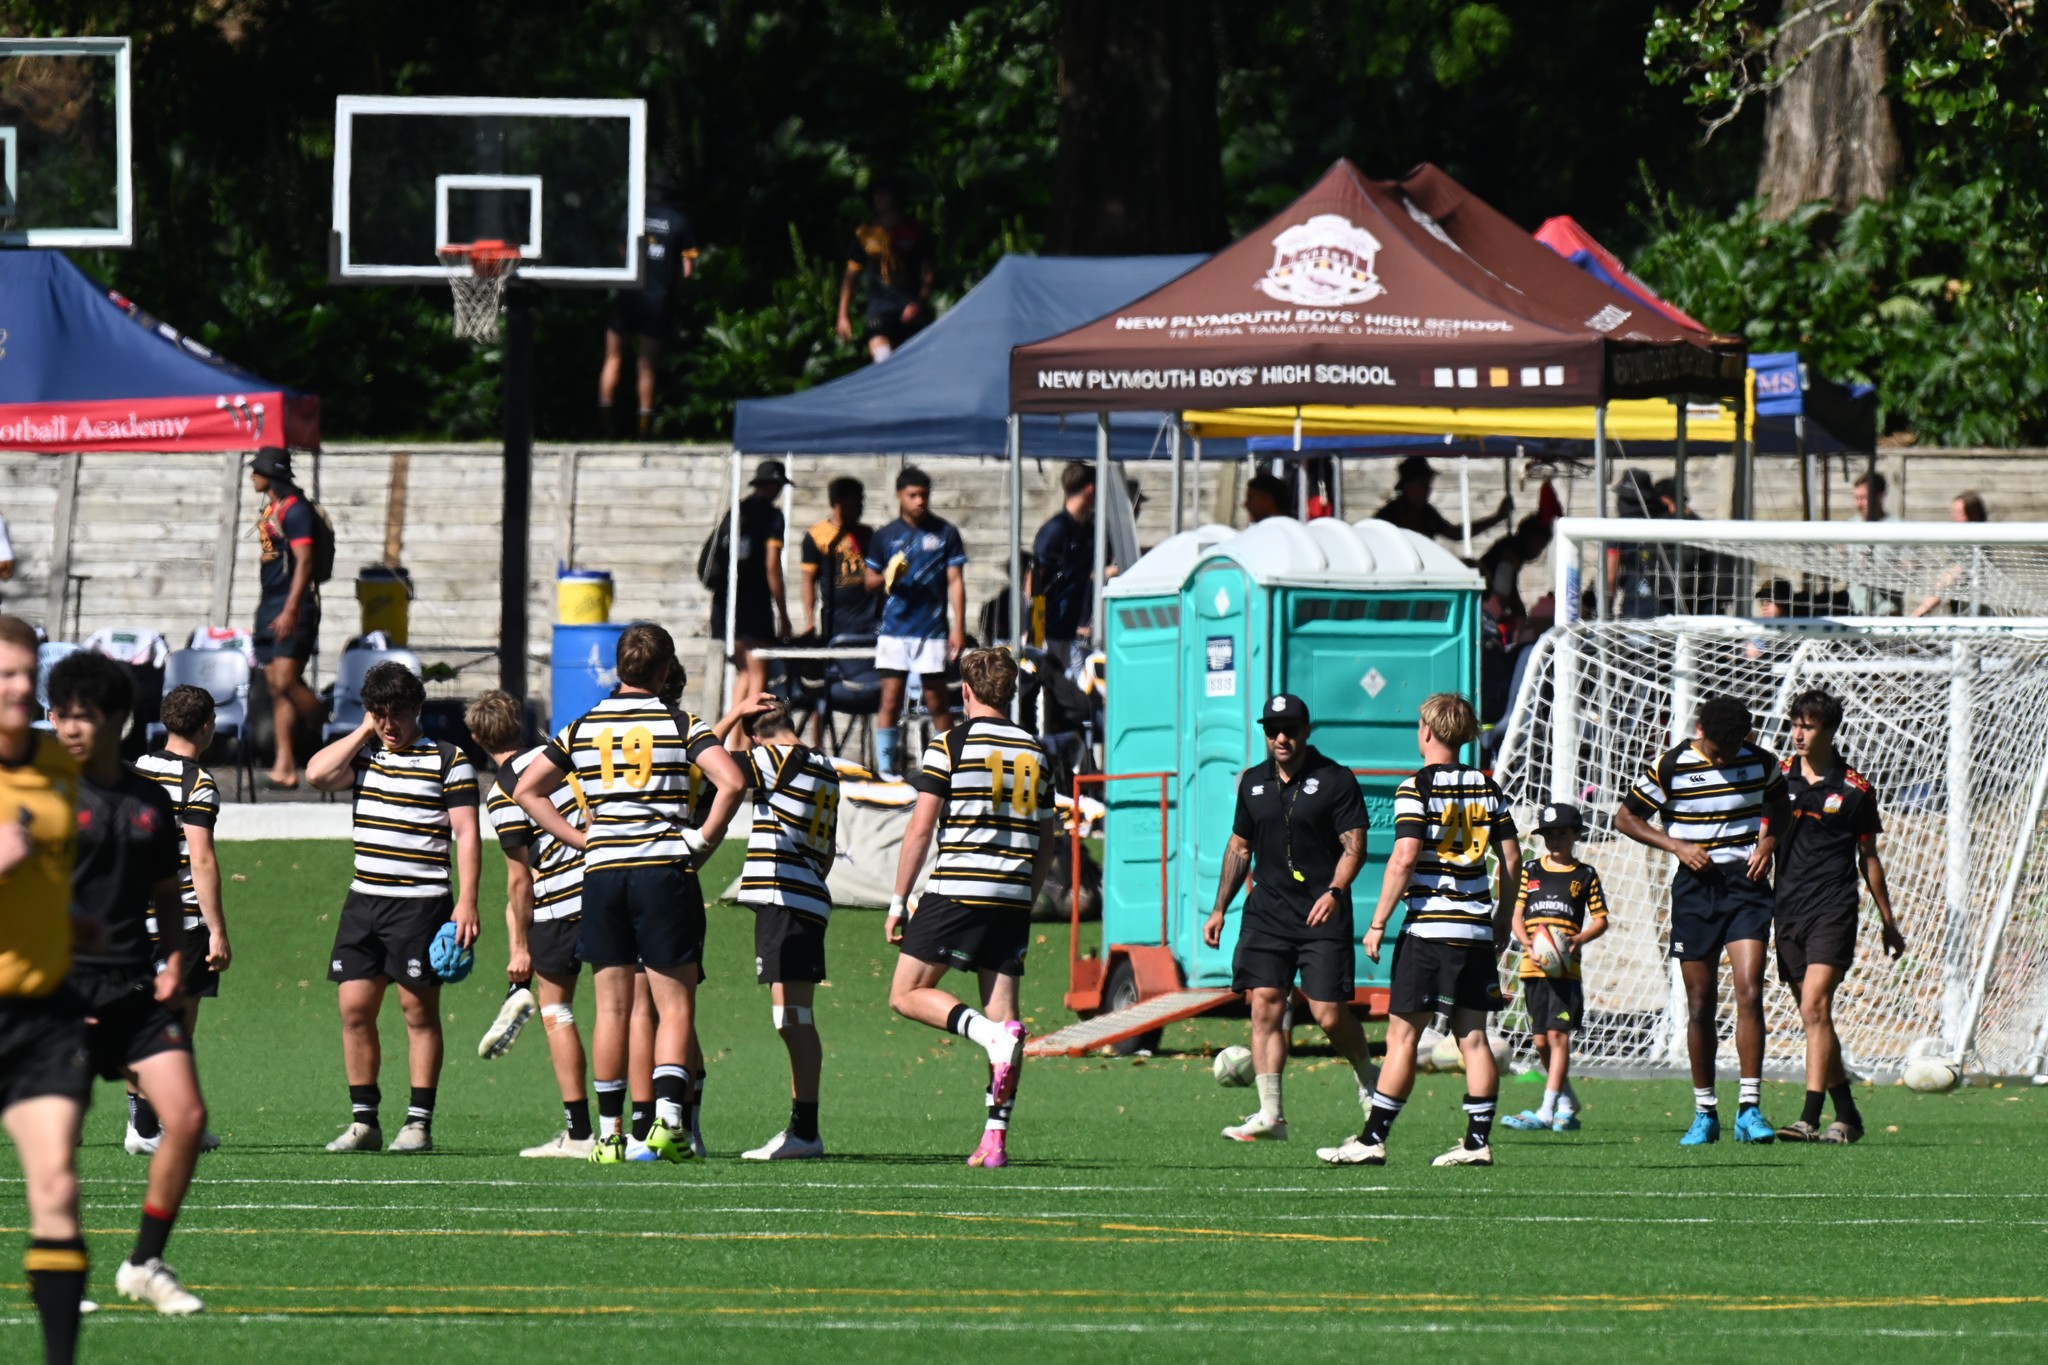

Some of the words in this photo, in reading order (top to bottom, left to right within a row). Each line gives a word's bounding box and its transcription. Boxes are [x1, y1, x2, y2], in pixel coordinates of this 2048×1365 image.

[1115, 316, 1167, 330] NEW
[1171, 310, 1291, 328] PLYMOUTH
[1365, 313, 1420, 328] HIGH
[1424, 317, 1514, 332] SCHOOL
[1168, 329, 1189, 339] TE
[1194, 325, 1244, 338] KURA
[1038, 370, 1084, 388] NEW
[1086, 368, 1195, 389] PLYMOUTH
[1199, 365, 1257, 388] BOYS'
[1261, 364, 1311, 385] HIGH
[1314, 363, 1397, 386] SCHOOL
[73, 411, 190, 441] Academy
[592, 726, 654, 790] 19
[984, 750, 1040, 816] 10
